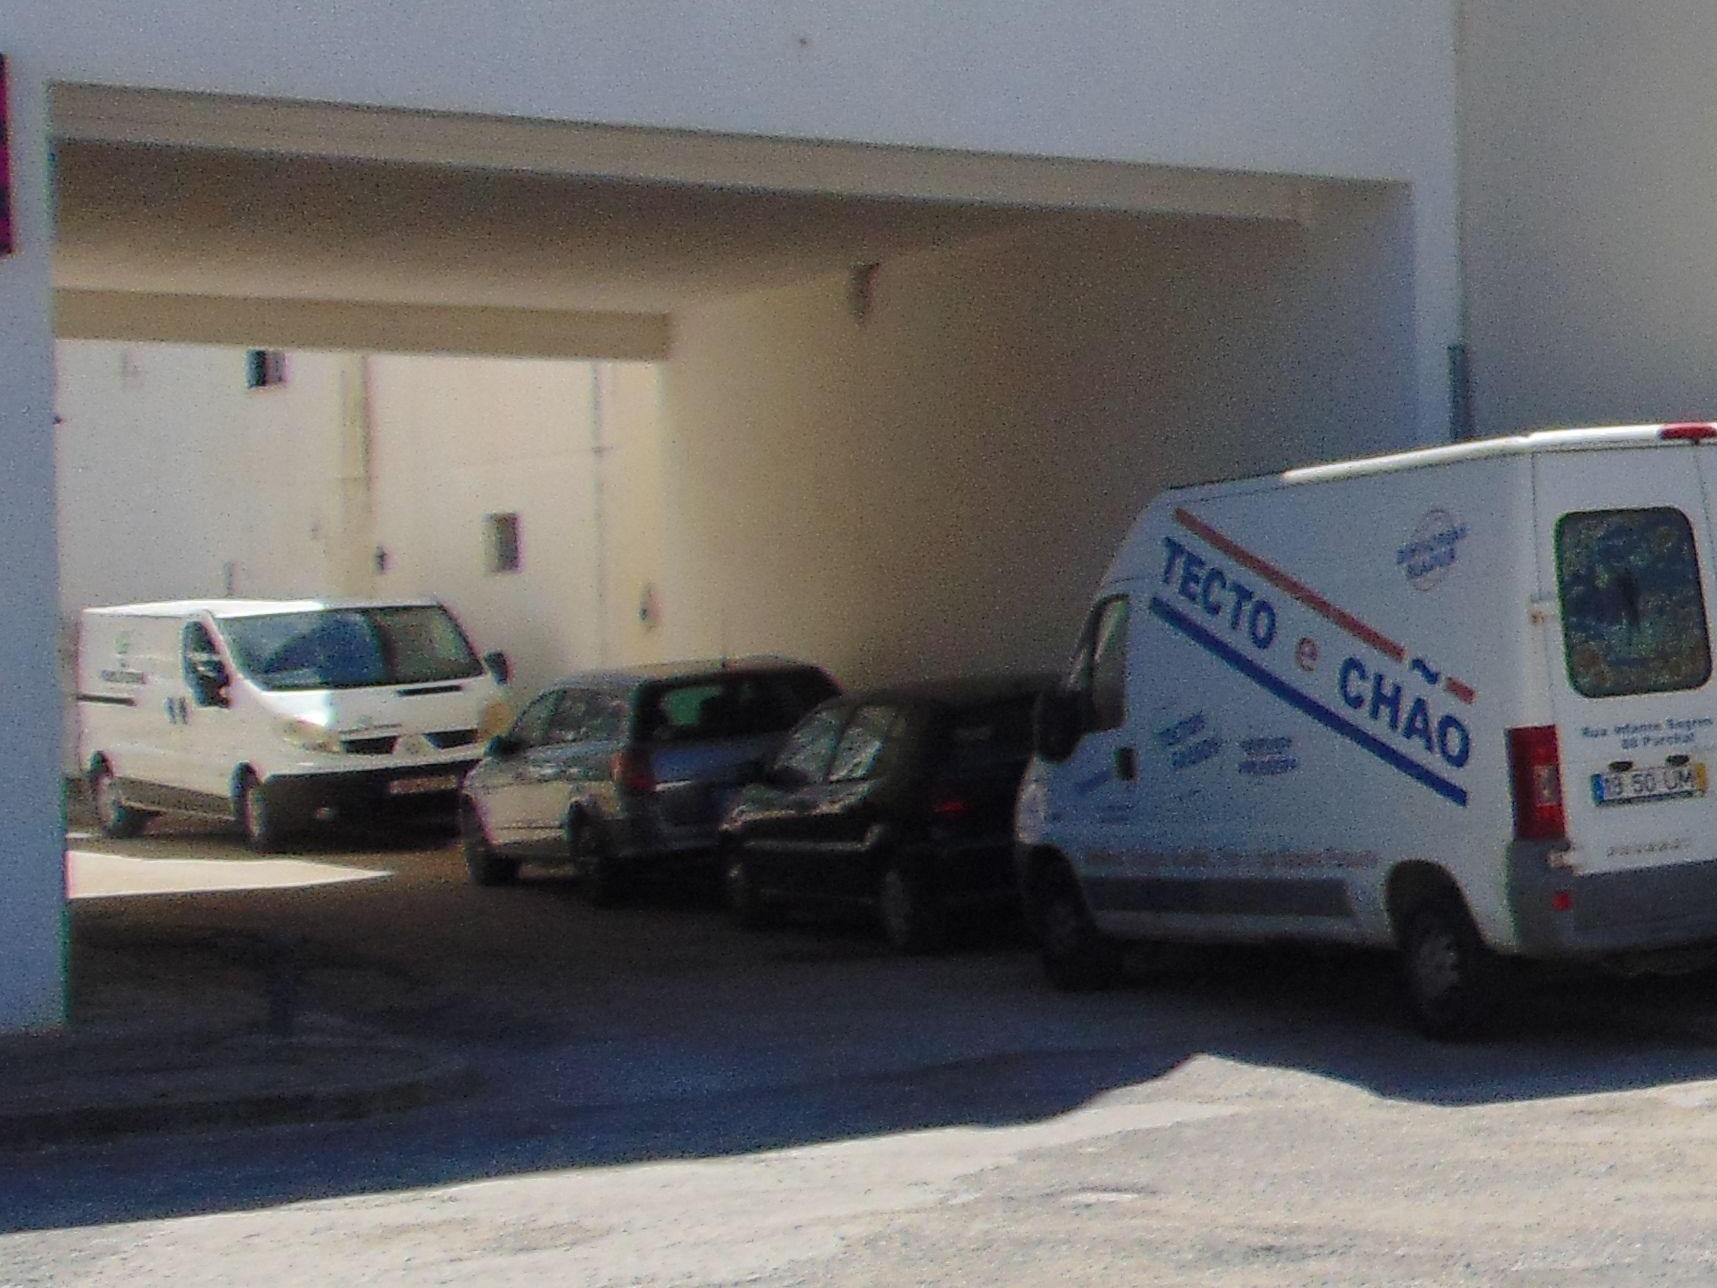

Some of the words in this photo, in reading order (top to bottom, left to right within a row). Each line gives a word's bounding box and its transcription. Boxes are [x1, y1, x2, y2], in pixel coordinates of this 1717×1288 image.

[1161, 535, 1277, 651] TECTO
[1294, 635, 1319, 673] e
[1338, 656, 1472, 770] CHÃO
